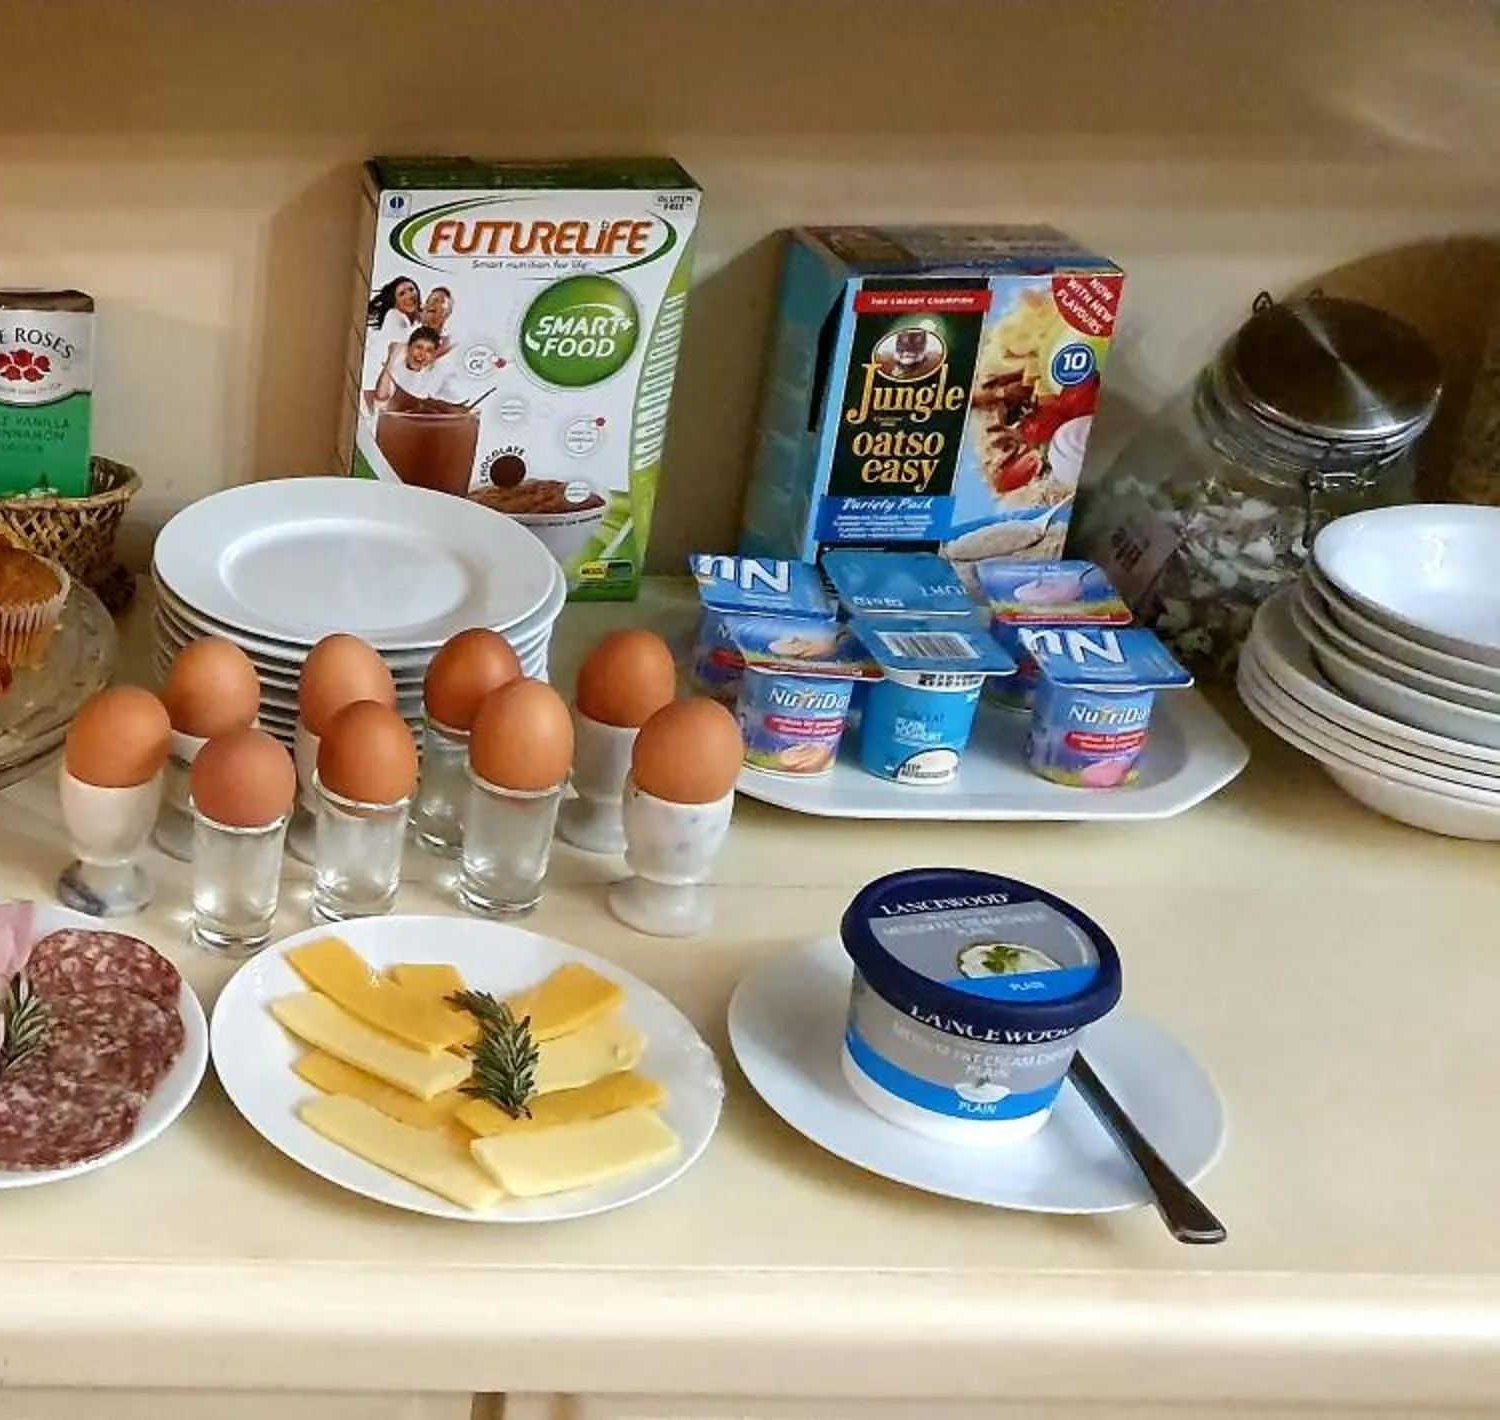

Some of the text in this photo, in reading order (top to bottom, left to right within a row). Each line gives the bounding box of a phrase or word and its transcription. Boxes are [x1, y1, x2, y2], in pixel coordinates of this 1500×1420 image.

[472, 259, 503, 269] Smart
[15, 327, 75, 359] ROSES
[542, 337, 616, 358] FOOD
[1063, 352, 1088, 371] 10
[846, 363, 965, 425] Jungle
[852, 430, 945, 457] oatso
[479, 445, 526, 484] CHOCOLATE
[861, 459, 940, 493] easy
[898, 497, 934, 509] Pack
[880, 892, 1010, 915] LANCEWOOD
[958, 1101, 997, 1114] PLAIN
